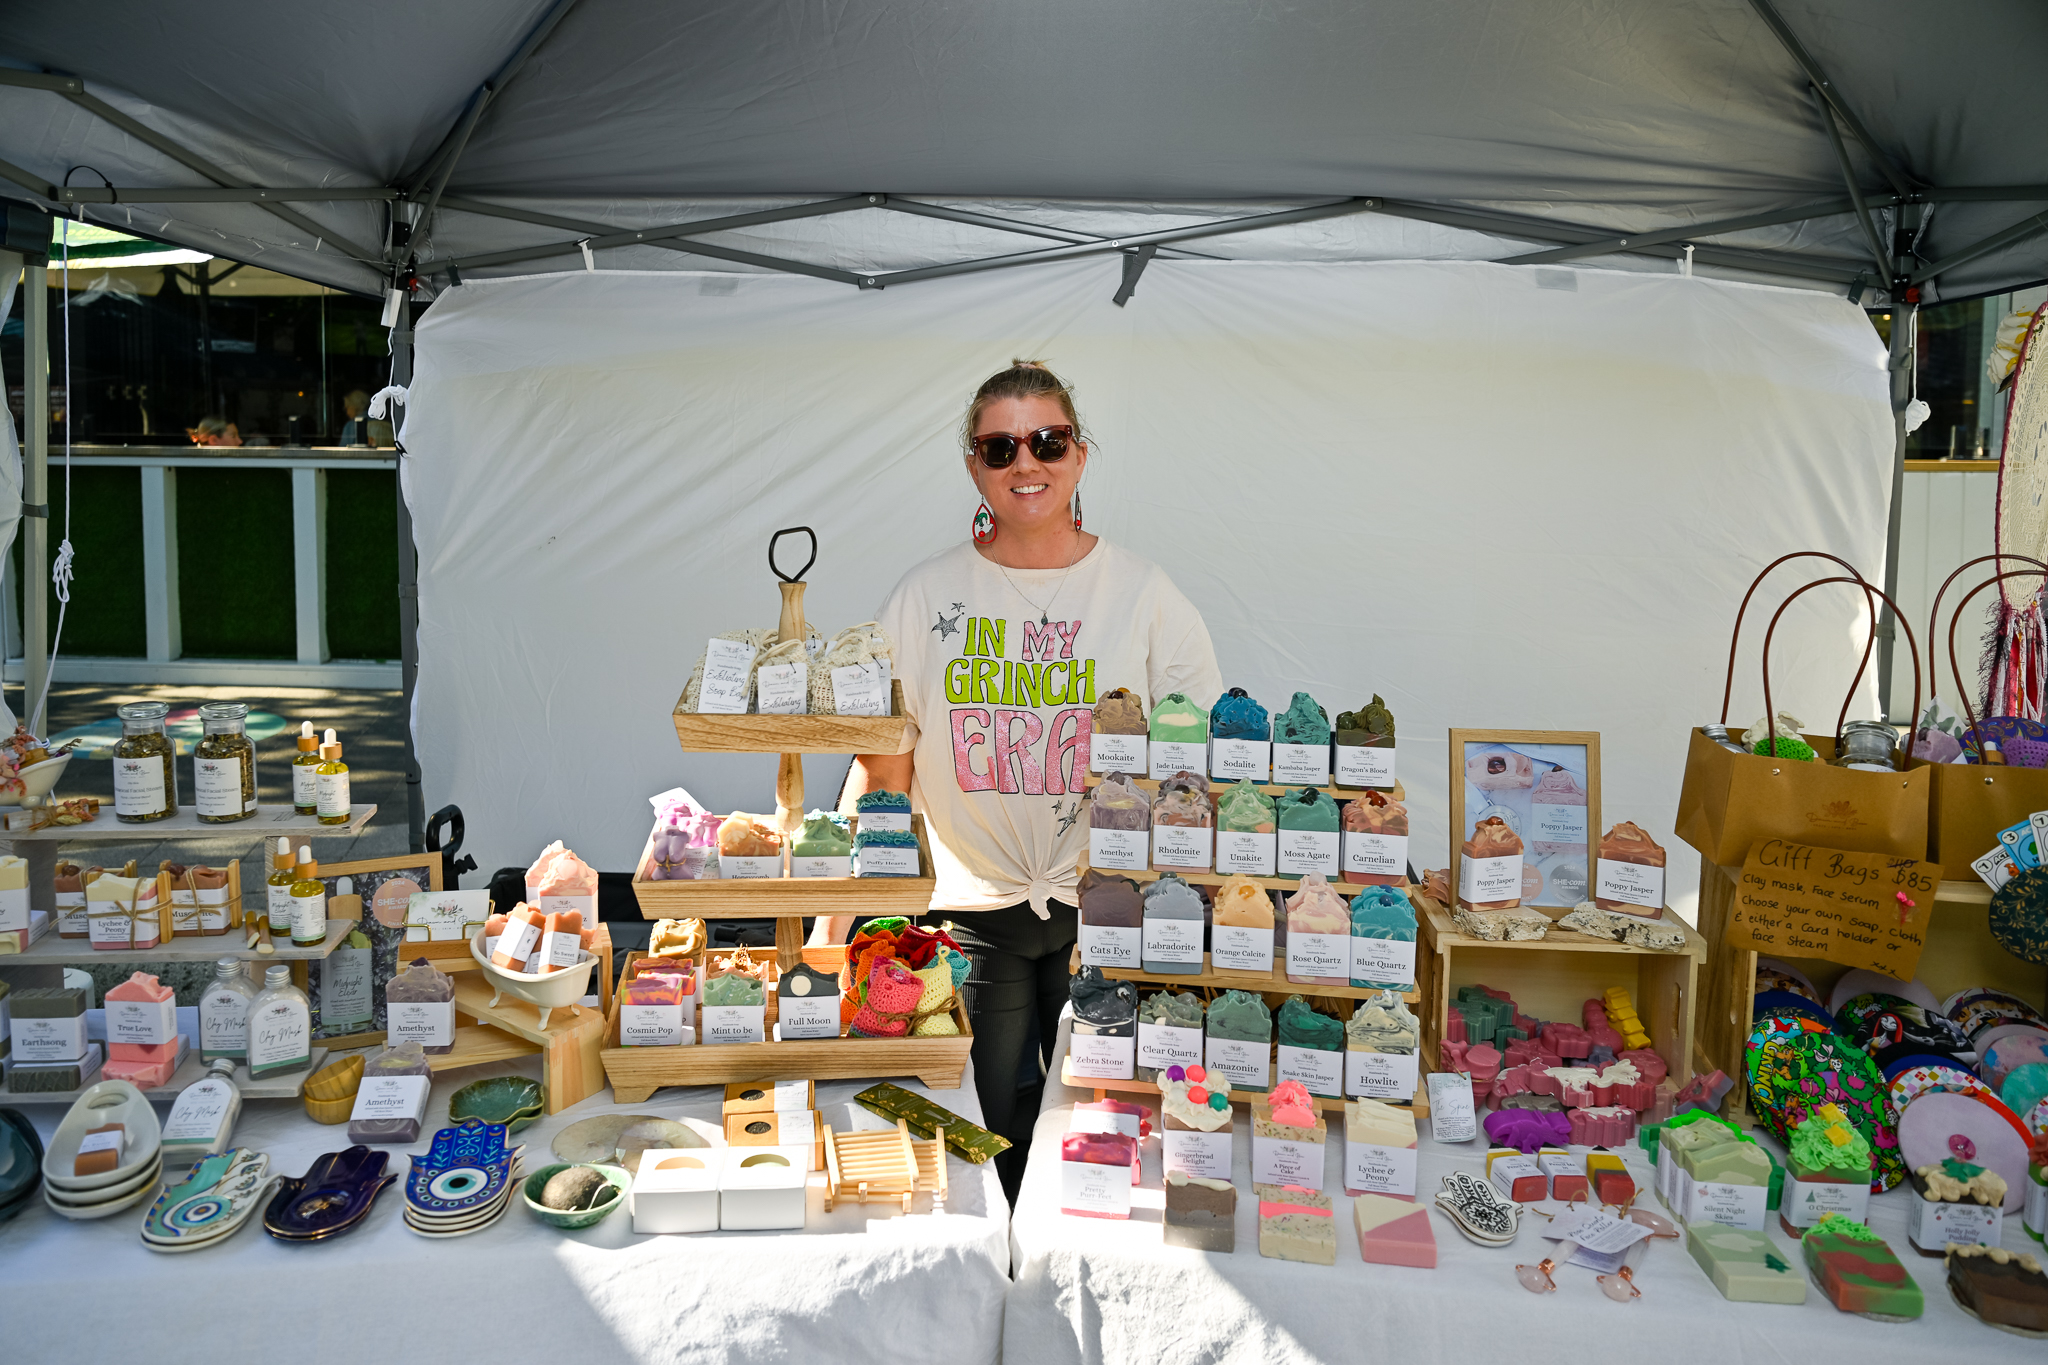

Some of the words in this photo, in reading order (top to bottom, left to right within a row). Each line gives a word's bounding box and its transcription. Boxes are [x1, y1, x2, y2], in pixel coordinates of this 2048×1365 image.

[963, 617, 1006, 658] IN
[1021, 619, 1082, 662] MY
[706, 669, 745, 687] Exfoliating
[945, 658, 1097, 708] GRINCH
[706, 683, 726, 698] Soap
[729, 686, 744, 702] Bag
[762, 696, 801, 710] Exfoliating
[840, 698, 880, 712] Exfoliating
[949, 708, 1093, 795] ERA
[1098, 754, 1134, 762] Mookaite
[1224, 760, 1256, 768] Sodalite
[1341, 766, 1368, 774] Dragon's
[1099, 848, 1133, 857] Amethyst
[1158, 846, 1200, 856] Rhodonite
[1284, 850, 1305, 858] Moss
[1307, 852, 1330, 860] Agate
[1230, 853, 1262, 862] Unakite
[1353, 854, 1396, 865] Carnelian
[1759, 840, 1812, 870] Gift
[1824, 853, 1879, 886] Bags
[1892, 866, 1932, 892] $85
[1604, 880, 1628, 890] Poppy
[1629, 884, 1654, 894] Jasper
[1743, 874, 1766, 890] Clay
[1772, 880, 1806, 895] mask,
[1812, 885, 1834, 898] Face
[1784, 904, 1810, 917] your
[1816, 910, 1842, 921] own
[98, 920, 122, 928] Lychee
[1749, 913, 1782, 930] either
[1786, 921, 1793, 929] a
[1837, 928, 1878, 944] holder
[1886, 942, 1902, 951] or
[1090, 946, 1111, 955] Cats
[1113, 947, 1131, 957] Eye
[1147, 942, 1196, 951] Labradorite
[1215, 948, 1240, 957] Orange
[1242, 950, 1265, 958] Calcite
[1292, 954, 1312, 963] Rose
[1313, 956, 1342, 966] Quartz
[1356, 958, 1375, 967] Blue
[1376, 960, 1406, 970] Quartz
[333, 975, 363, 990] Midnight
[206, 1017, 222, 1033] Clay
[806, 1017, 831, 1025] Moon
[397, 1025, 435, 1033] Amethyst
[627, 1026, 656, 1034] Cosmic
[658, 1026, 673, 1036] Pop
[712, 1026, 731, 1034] Mint
[743, 1026, 753, 1034] be
[259, 1030, 277, 1046] Clay
[279, 1025, 302, 1041] Mask
[22, 1039, 67, 1047] Earthsong
[1143, 1046, 1165, 1055] Clear
[1168, 1048, 1197, 1058] Quartz
[1076, 1056, 1099, 1064] Zebra
[1101, 1057, 1124, 1066] Stone
[1211, 1062, 1259, 1073] Amazonite
[1316, 1073, 1334, 1082] Jasper
[1360, 1076, 1398, 1086] Howlite
[365, 1098, 404, 1106] Amethyst
[175, 1106, 193, 1121] Clay
[194, 1106, 221, 1120] Mask
[1175, 1152, 1214, 1160] Gingerbread
[1358, 1165, 1384, 1174] Lychee
[1365, 1173, 1389, 1183] Peony
[1085, 1186, 1106, 1194] Pretty
[1945, 1227, 1963, 1235] Holly
[1948, 1234, 1977, 1242] Pudding
